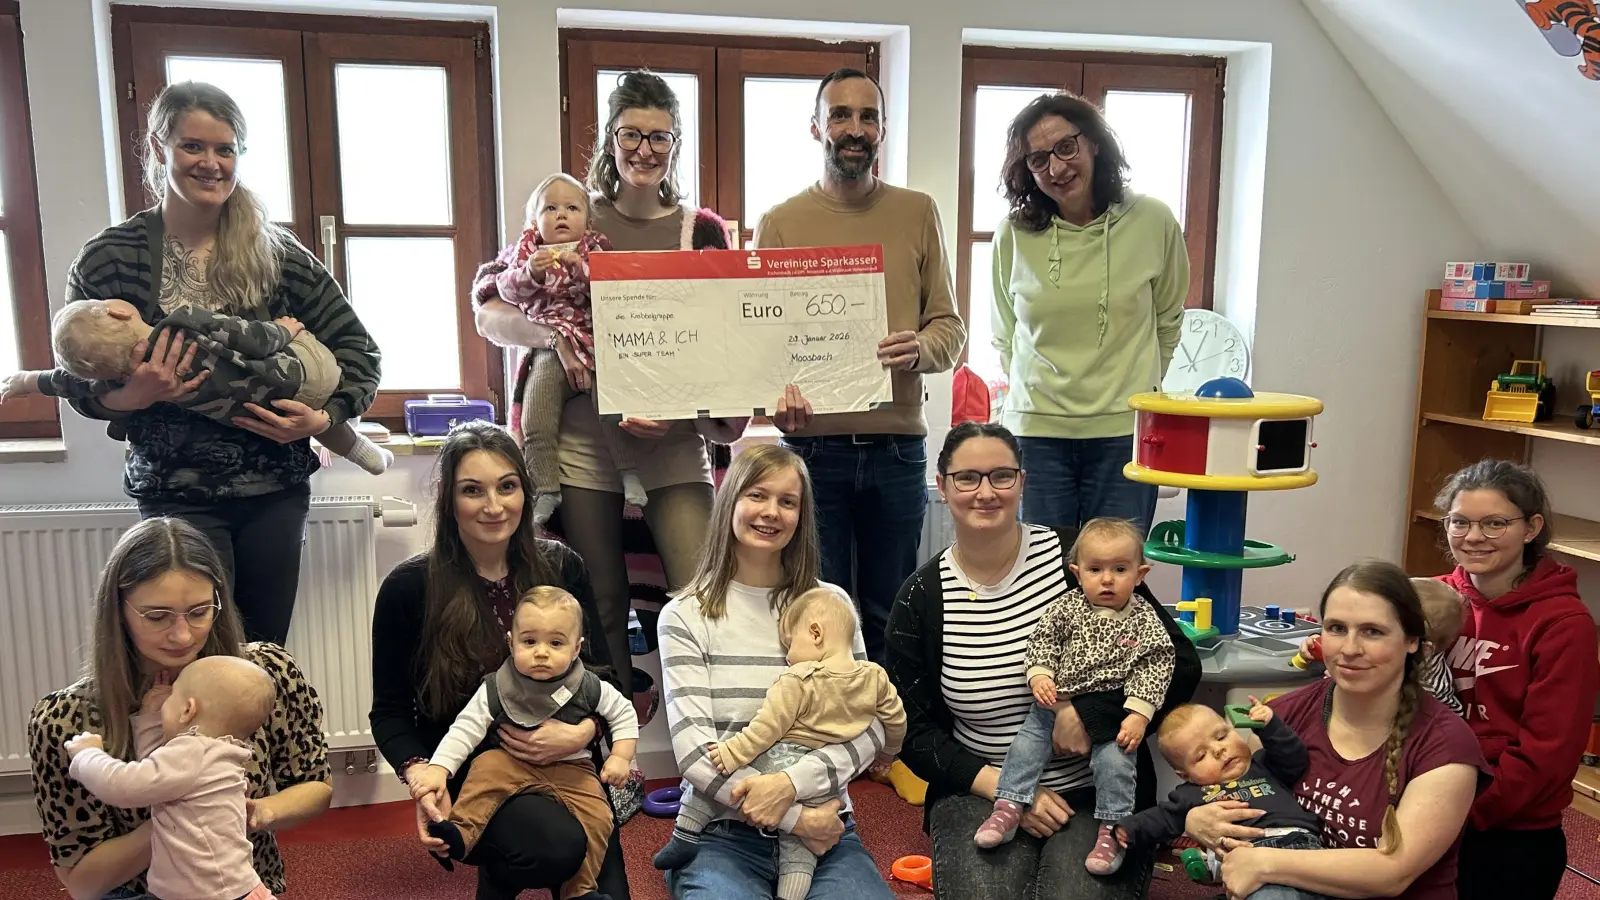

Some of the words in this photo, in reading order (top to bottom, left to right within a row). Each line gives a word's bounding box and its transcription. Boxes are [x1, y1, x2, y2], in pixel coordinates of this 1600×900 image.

[767, 259, 818, 270] Vereinigte
[820, 256, 877, 269] Sparkassen
[623, 294, 644, 302] Spende
[790, 290, 808, 298] Betrag
[742, 302, 783, 318] Euro
[1190, 318, 1204, 332] 12
[1214, 323, 1218, 338] 1
[659, 330, 668, 345] &
[675, 329, 698, 345] ICH
[801, 334, 827, 346] Januar
[829, 332, 850, 341] 2026
[1224, 338, 1236, 352] 2
[791, 352, 833, 362] Moosbach
[1230, 358, 1240, 373] 3
[1446, 635, 1501, 672] NIE
[1466, 702, 1490, 720] IR
[1302, 778, 1360, 808] LIGHT
[1312, 791, 1343, 810] THE
[1296, 795, 1368, 831] NIVERSE
